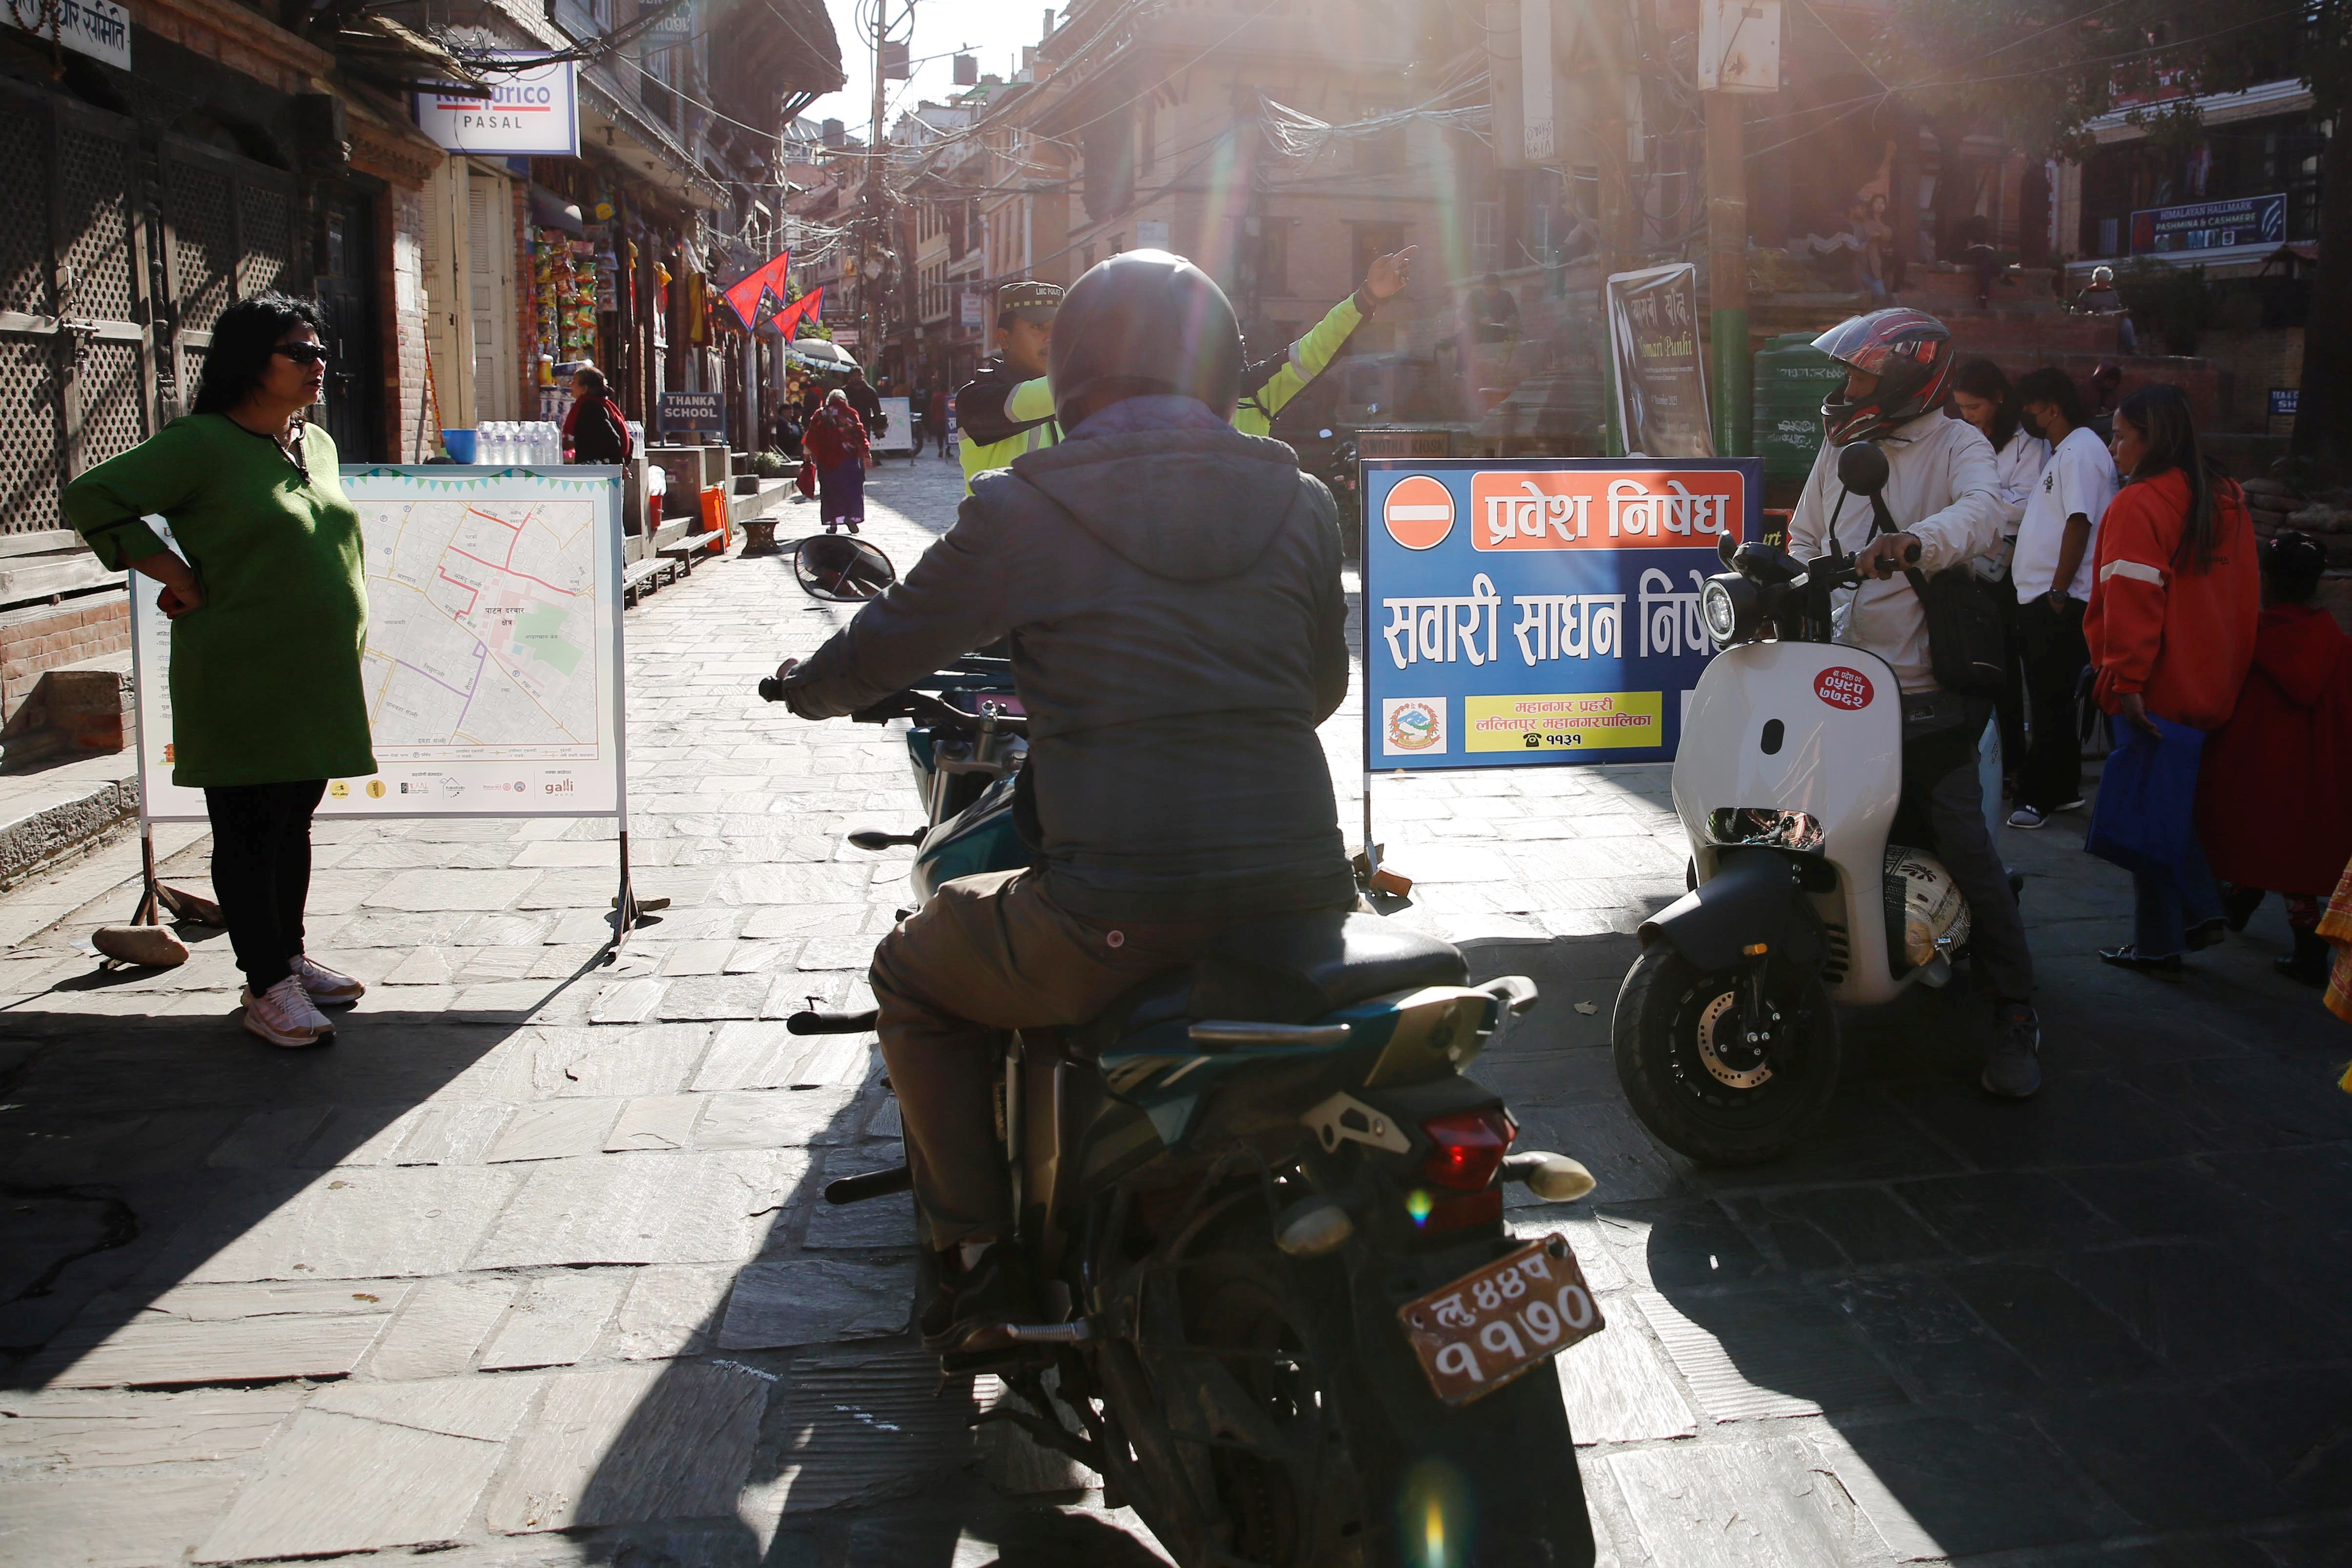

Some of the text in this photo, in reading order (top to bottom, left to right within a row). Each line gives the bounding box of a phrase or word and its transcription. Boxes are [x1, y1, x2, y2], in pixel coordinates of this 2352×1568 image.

[464, 116, 523, 128] PASAL
[2161, 201, 2252, 220] HIMALAYAN HALLMARK
[2156, 220, 2198, 231] PASHMINA
[2208, 212, 2257, 226] CASHMERE
[1638, 330, 1693, 358] Yomari Punhi
[666, 396, 716, 406] THANKA
[2272, 391, 2286, 399] TEA
[664, 407, 718, 417] SCHOOL
[2278, 400, 2297, 408] SH
[1361, 438, 1445, 454] SWOTHA KIOSK
[1484, 479, 1730, 546] प्रवेश निषेध
[1383, 568, 1723, 670] सवारी साधन निषे
[1514, 697, 1614, 714] महानगर प्रहरी
[1819, 687, 1863, 708] ७७६२
[1475, 713, 1652, 733] ललितपुर महानगरपालिका
[1546, 735, 1581, 746] ११३१
[545, 778, 574, 794] galli
[1435, 1284, 1593, 1382] ११७०
